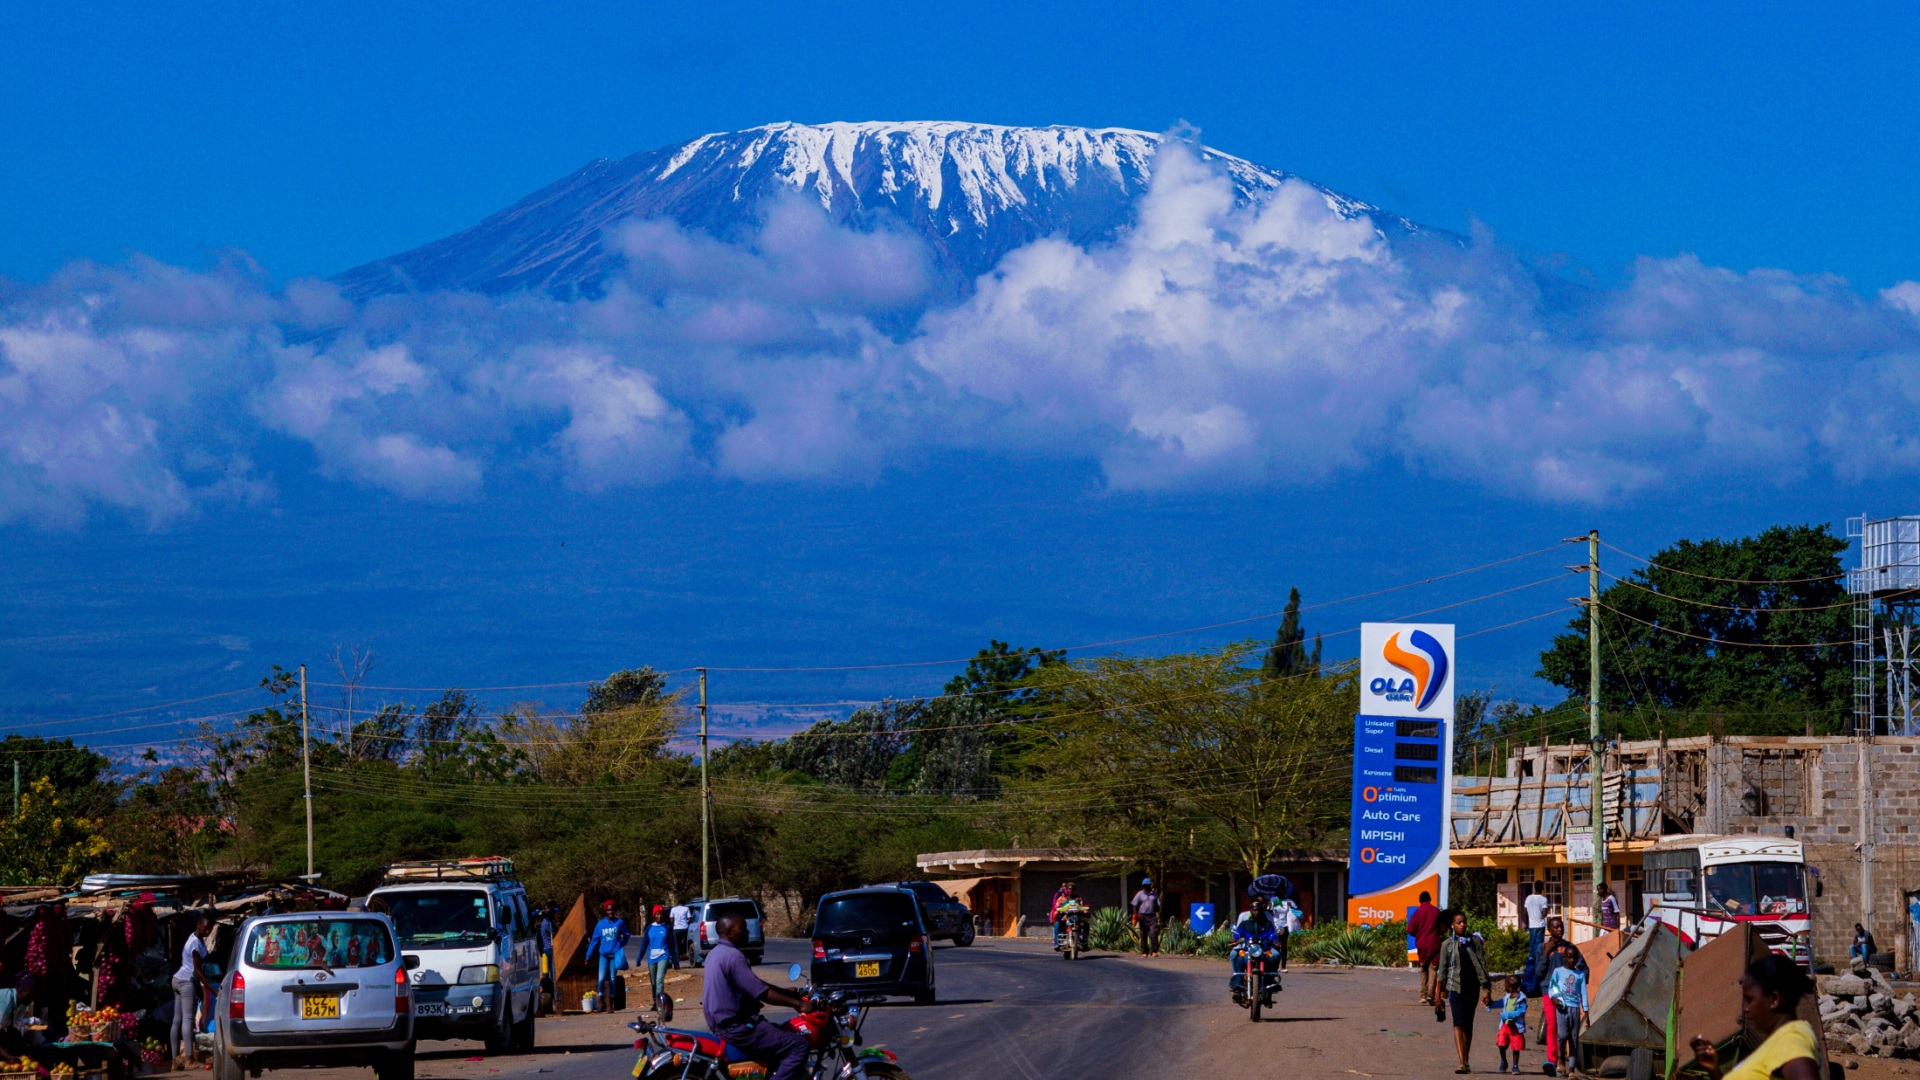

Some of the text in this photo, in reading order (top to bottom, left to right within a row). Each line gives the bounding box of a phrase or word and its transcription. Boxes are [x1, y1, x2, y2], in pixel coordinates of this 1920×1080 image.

[1370, 677, 1414, 693] OLA
[1386, 693, 1413, 702] ENERGY
[1365, 720, 1394, 728] Unleaded
[1364, 746, 1384, 754] Diesel
[1362, 809, 1421, 822] Auto Care
[1361, 830, 1405, 841] MPISHI
[1358, 906, 1394, 921] Shop
[305, 995, 328, 1006] KCZ
[305, 1006, 336, 1016] 847M
[417, 1005, 443, 1015] 893K
